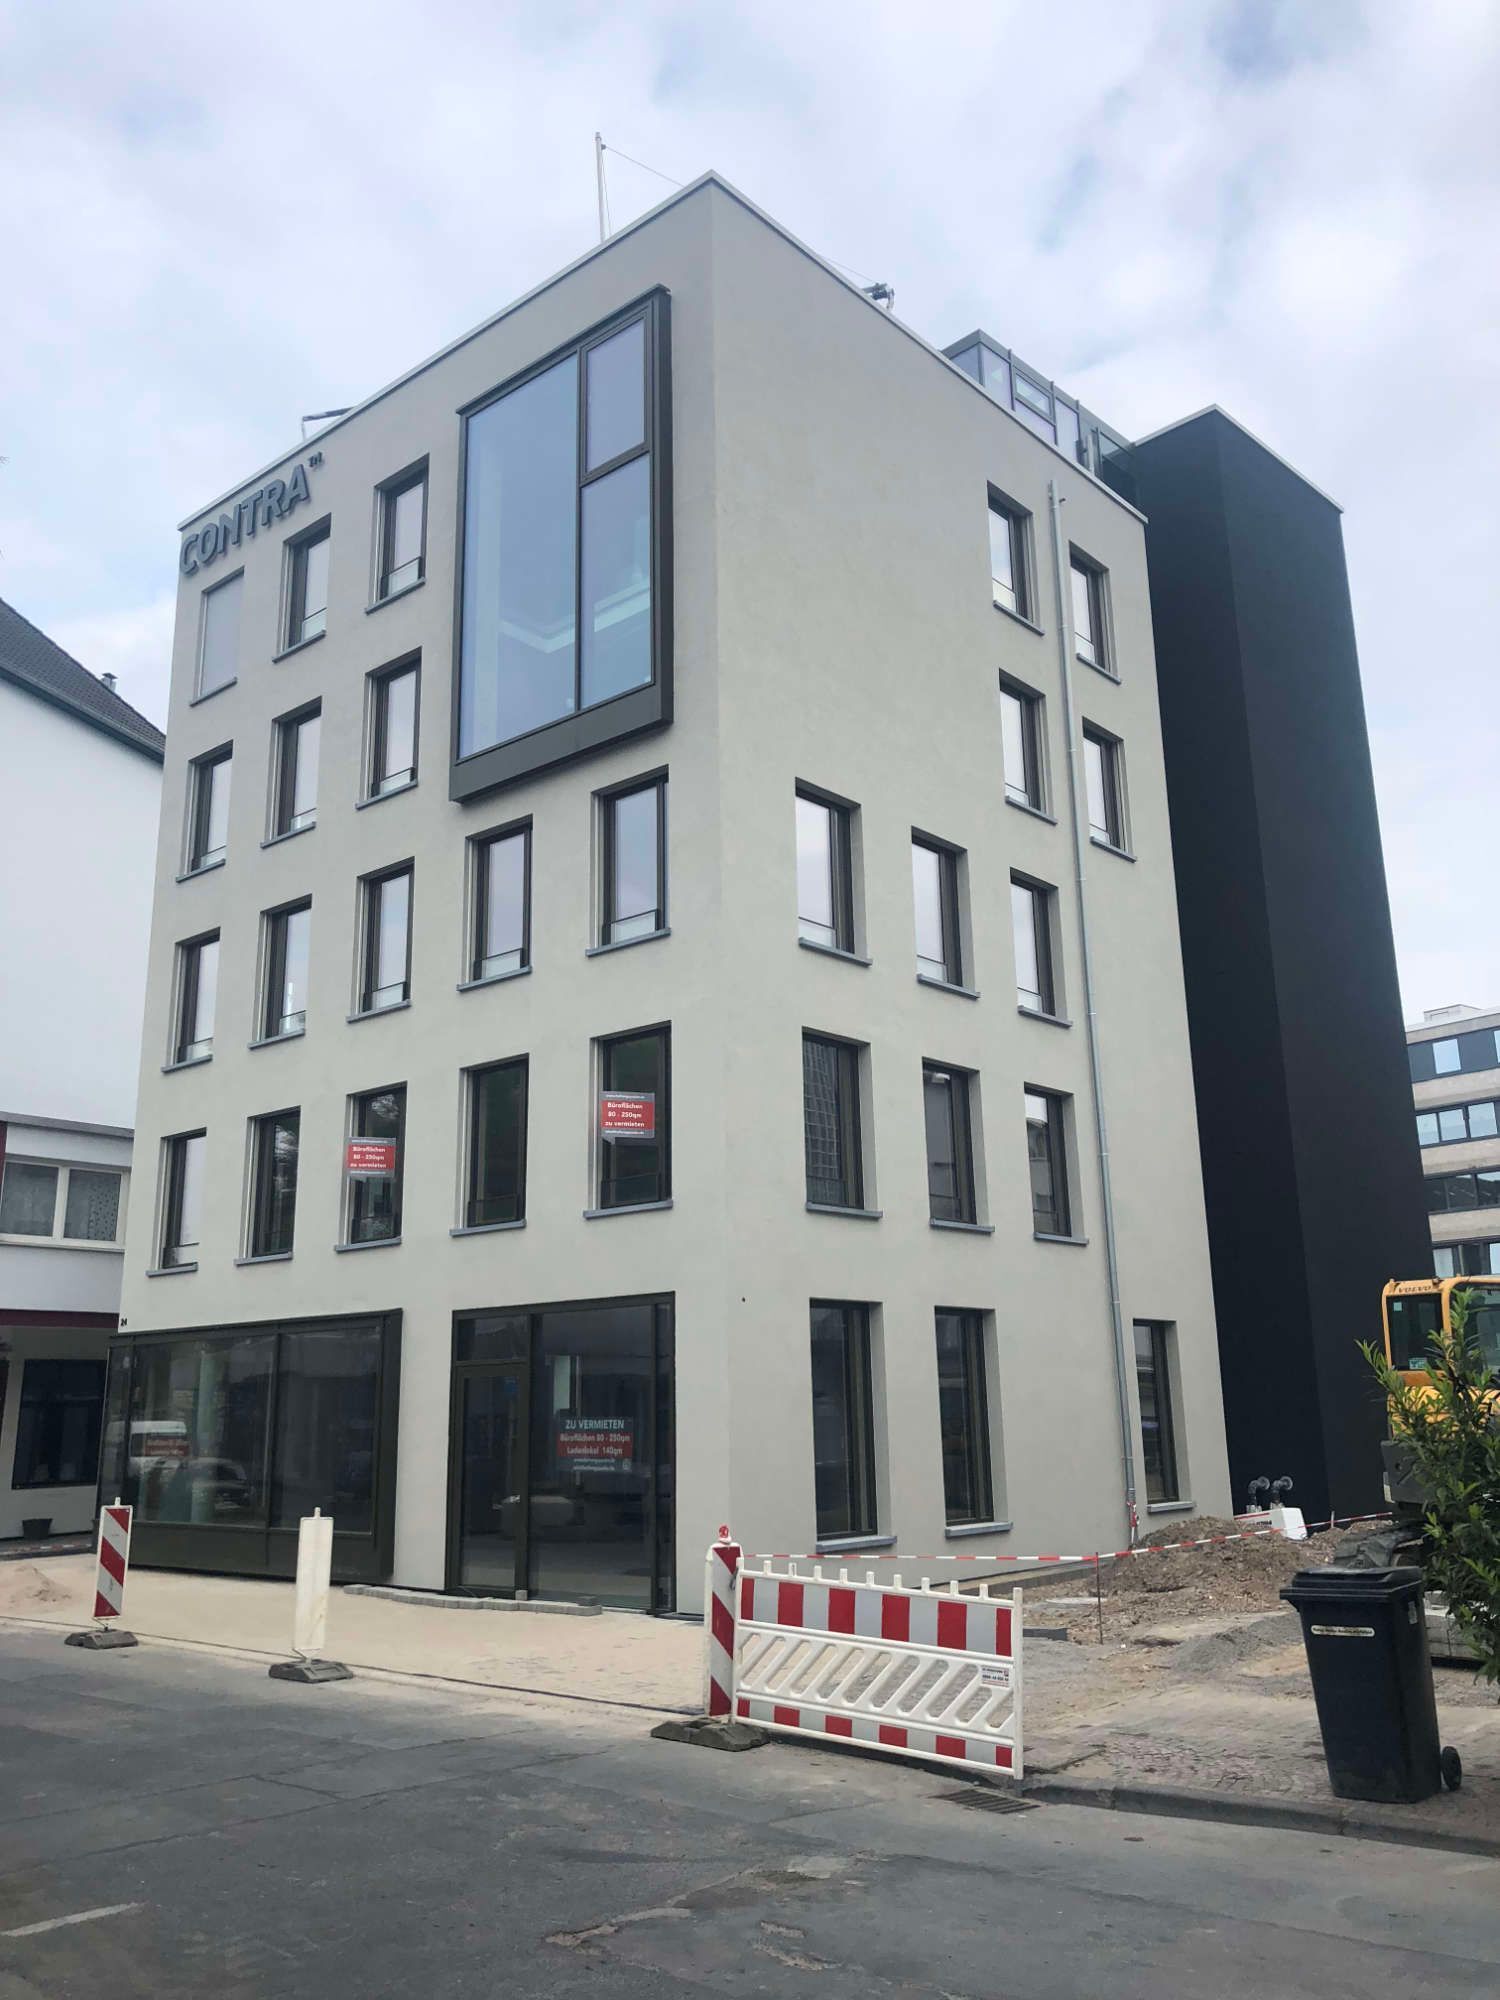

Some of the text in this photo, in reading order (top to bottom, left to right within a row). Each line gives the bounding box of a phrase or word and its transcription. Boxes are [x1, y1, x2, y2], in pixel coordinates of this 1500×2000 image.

[180, 463, 310, 575] CONTRA
[607, 1101, 643, 1109] Büroflächen
[621, 1111, 642, 1119] 250qm
[1398, 1285, 1432, 1293] VOLVO
[121, 1317, 128, 1327] 24
[565, 1419, 625, 1429] ZU VERMIETEN
[560, 1433, 595, 1442] Büroflächen
[609, 1433, 630, 1444] 250qm
[567, 1446, 623, 1456] Ladenlokal 140qm
